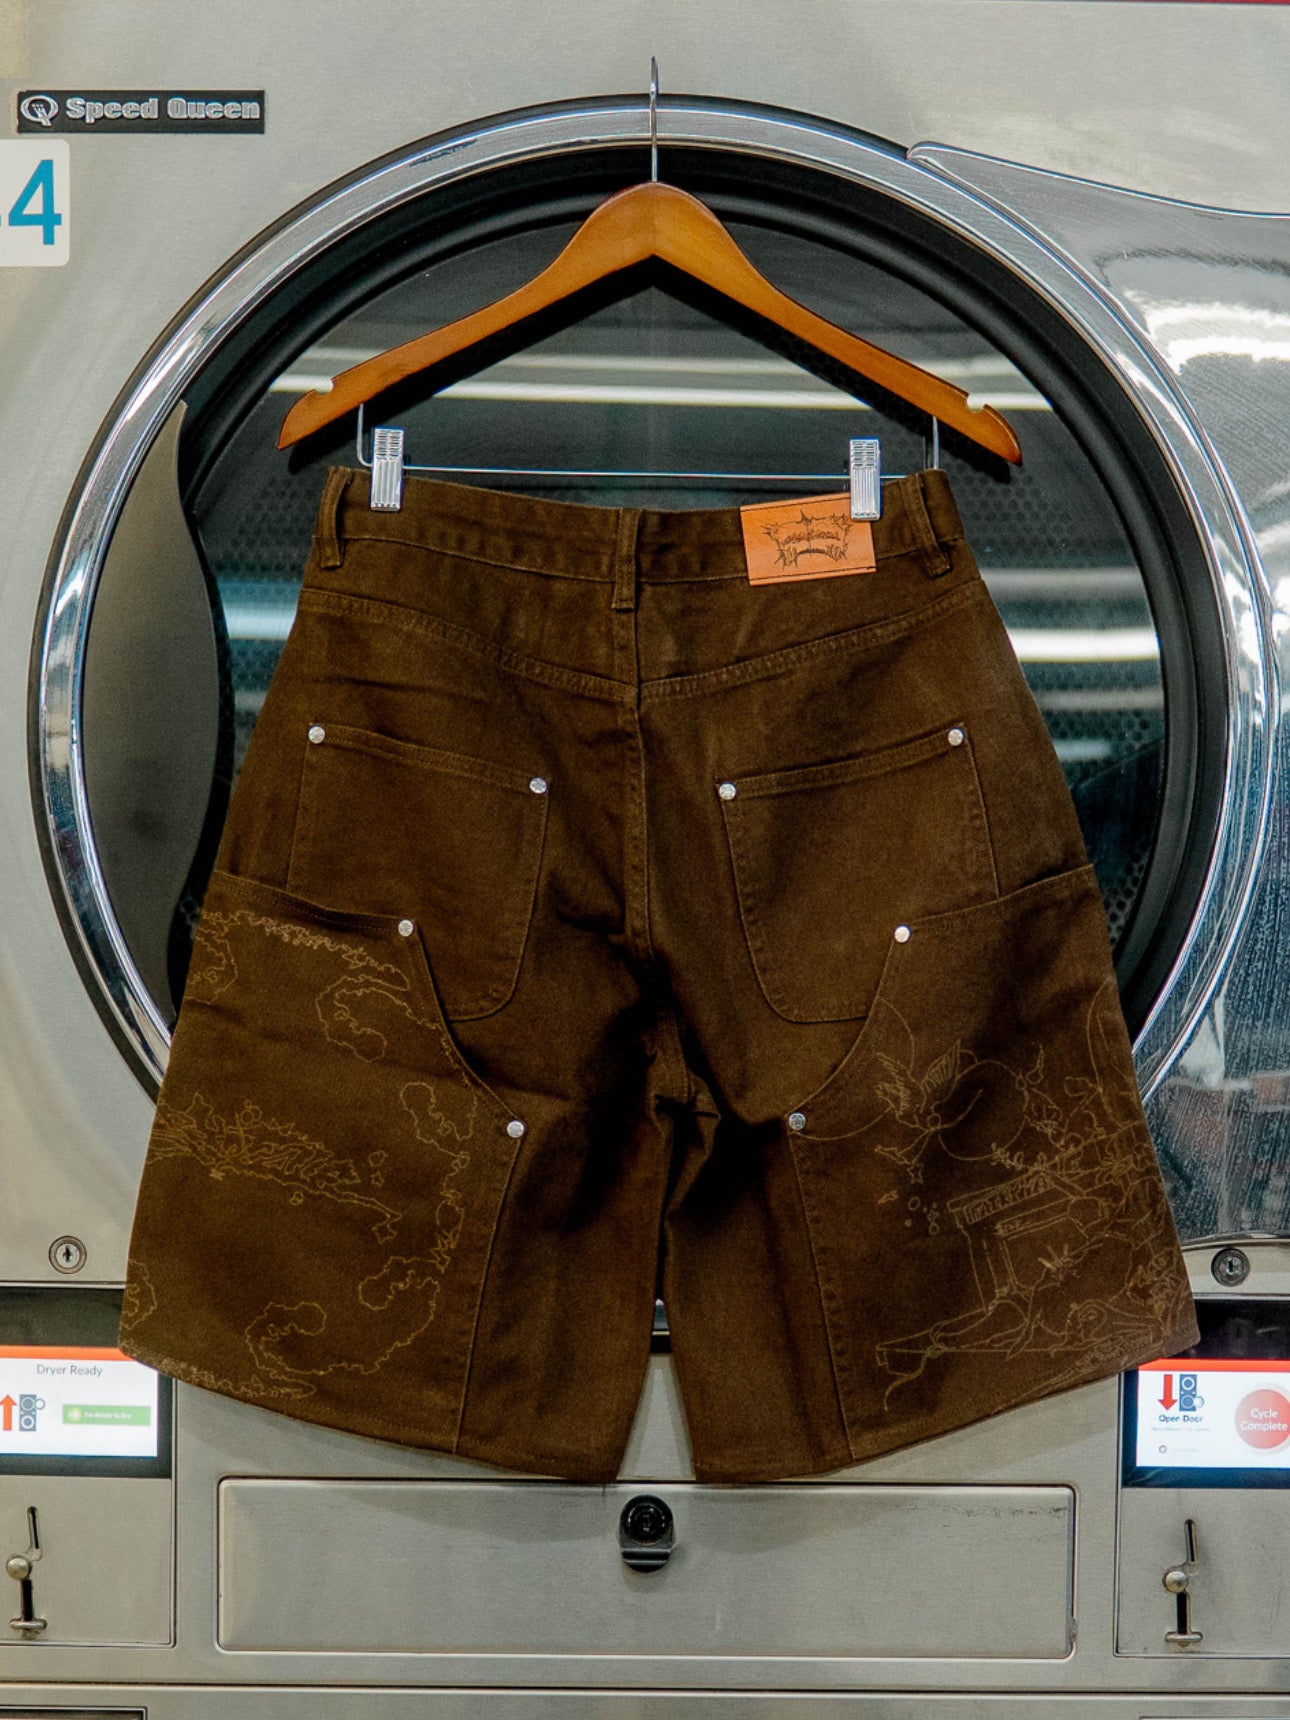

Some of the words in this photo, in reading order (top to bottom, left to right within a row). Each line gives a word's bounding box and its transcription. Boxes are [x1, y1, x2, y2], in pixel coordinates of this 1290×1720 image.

[66, 98, 158, 123] Speed
[167, 98, 260, 119] Queen
[0, 159, 62, 245] 4
[36, 1364, 66, 1376] Dryer
[70, 1365, 103, 1377] Ready
[1183, 1414, 1203, 1422] Door
[1250, 1408, 1279, 1419] Cycle
[1240, 1421, 1288, 1432] Complete
